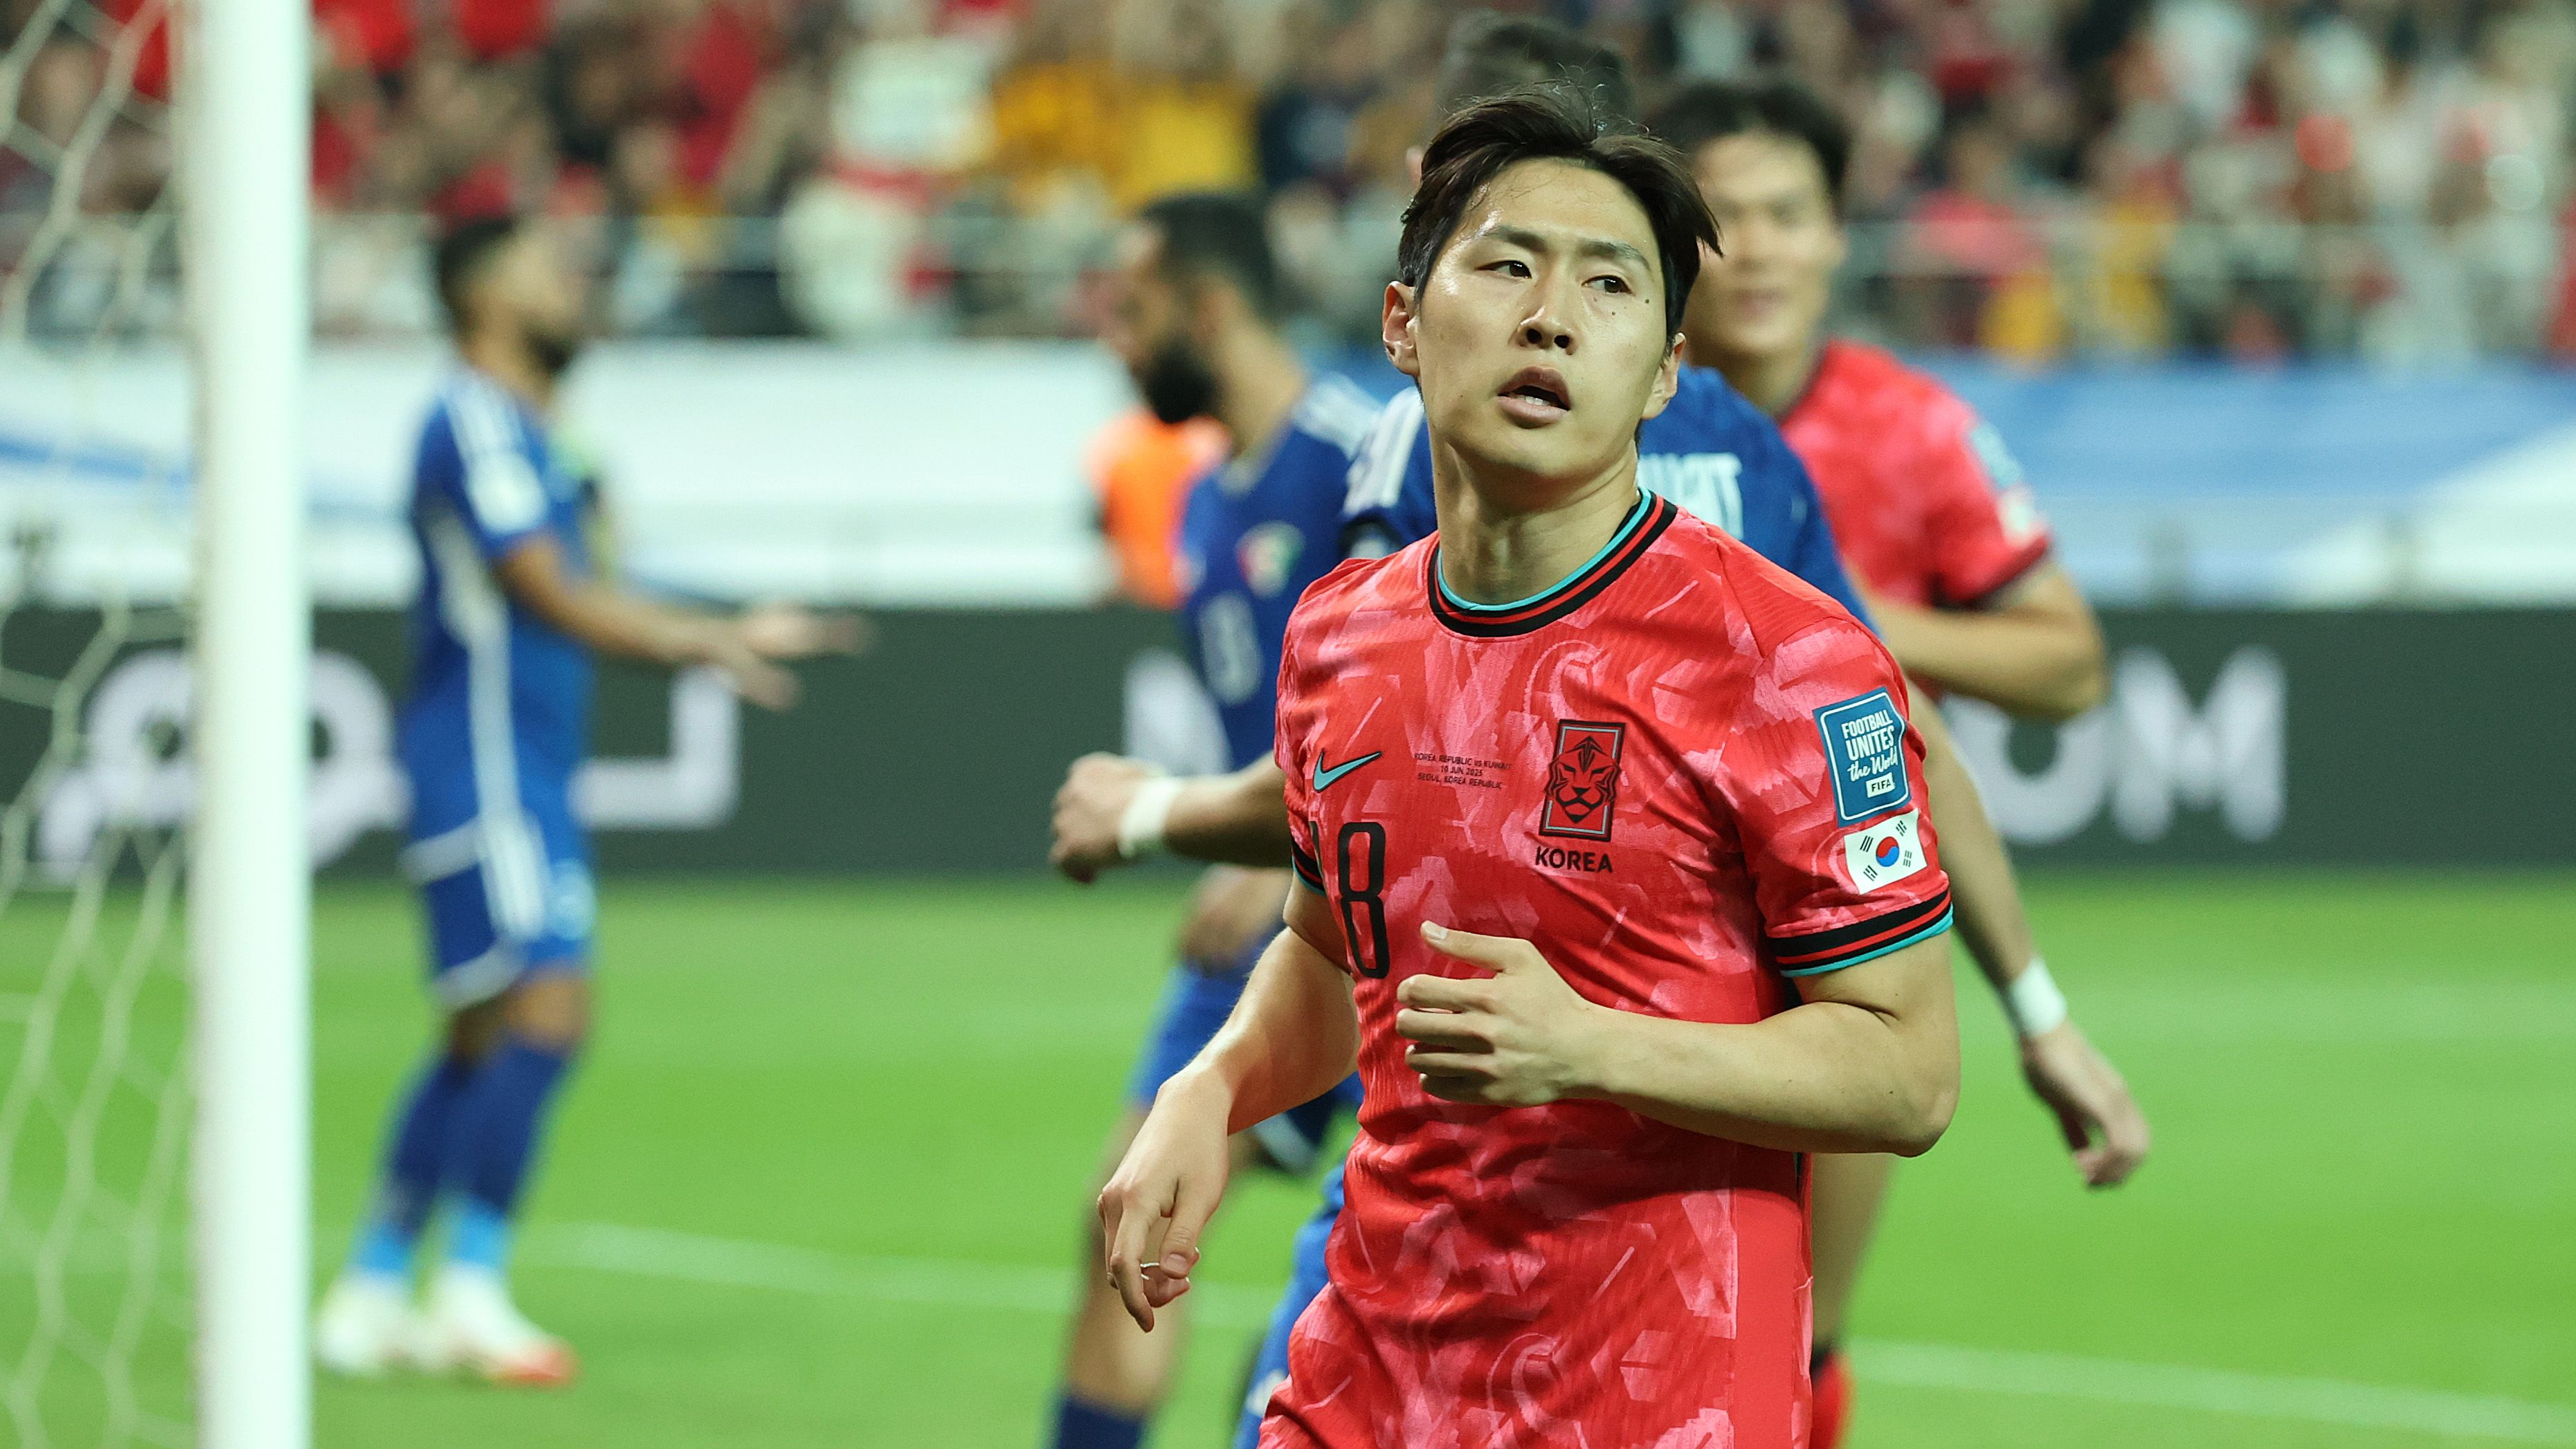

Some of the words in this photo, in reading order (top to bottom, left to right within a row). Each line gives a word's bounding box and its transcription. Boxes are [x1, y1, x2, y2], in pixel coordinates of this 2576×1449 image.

[1841, 709, 1893, 738] FOOTBALL
[1845, 725, 1894, 760] UNITES
[1414, 753, 1436, 761] KOREA
[1439, 755, 1473, 766] REPUBLIC
[1847, 760, 1870, 781] the
[1870, 745, 1898, 774] World
[1450, 766, 1464, 774] JUN
[1466, 767, 1483, 776] 2025
[1444, 776, 1466, 784] KOREA
[1469, 778, 1503, 789] REPUBLIC
[1871, 779, 1891, 792] FIFA
[1535, 846, 1614, 873] KOREA
